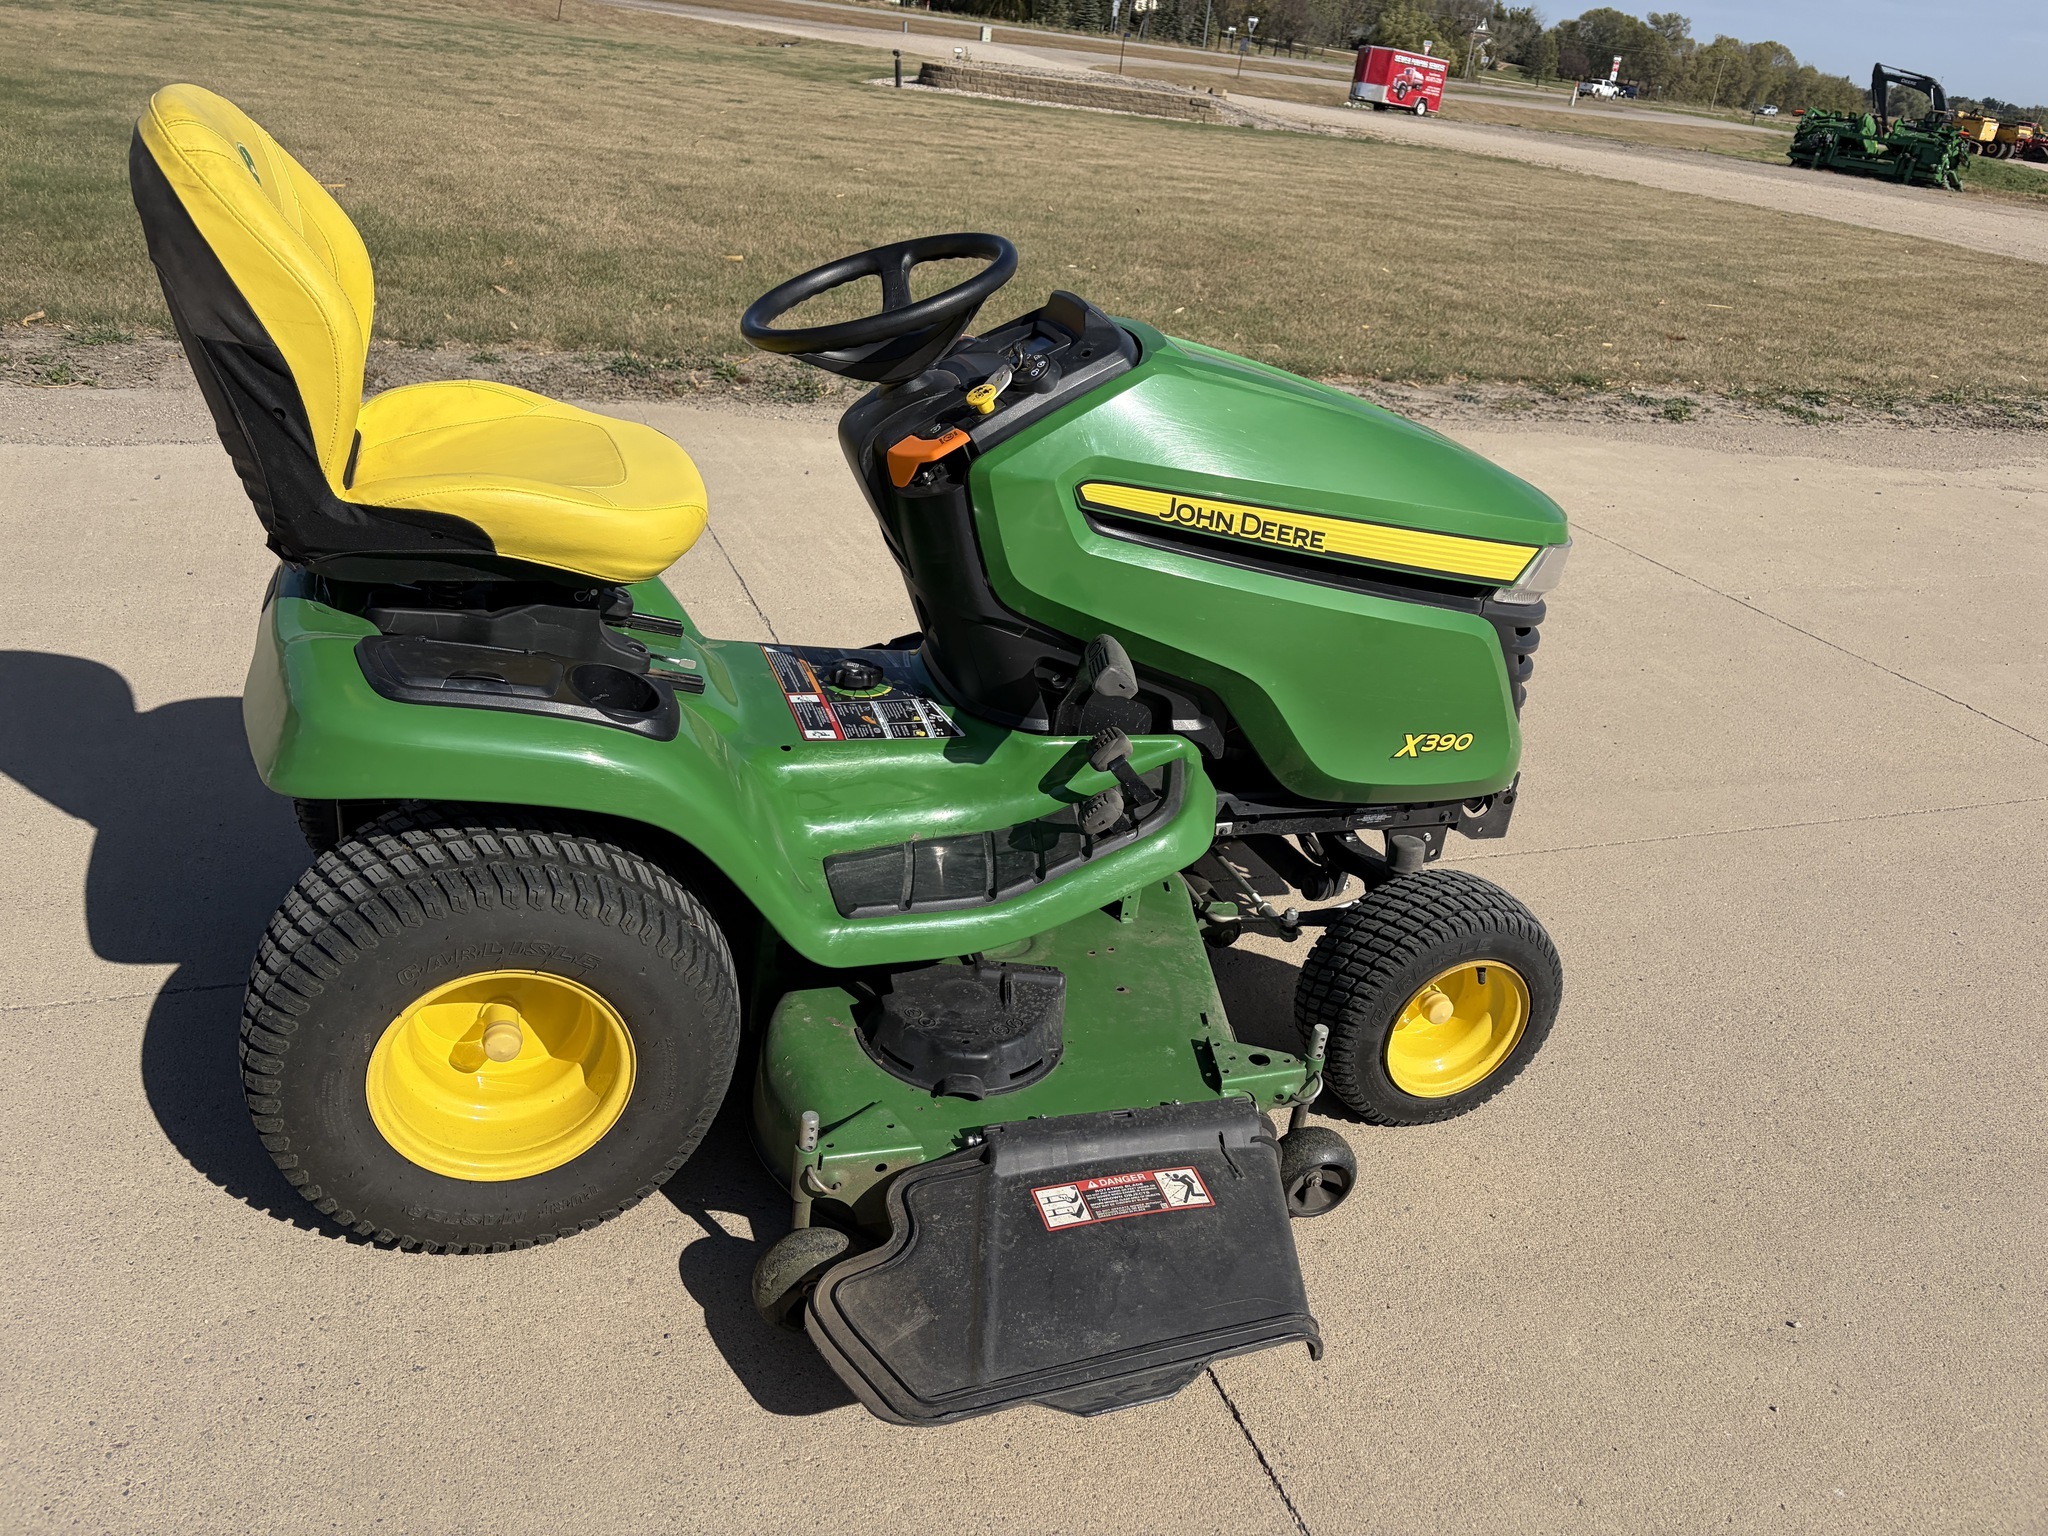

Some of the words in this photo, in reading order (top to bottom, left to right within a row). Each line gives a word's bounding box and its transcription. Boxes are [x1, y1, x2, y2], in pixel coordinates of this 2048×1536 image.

[1159, 497, 1235, 533] JOHN
[1239, 511, 1327, 551] DEERE
[1390, 732, 1474, 759] X390
[396, 940, 603, 987] CARLISLE
[1098, 1173, 1146, 1187] DANGER
[407, 1204, 528, 1227] MASTER
